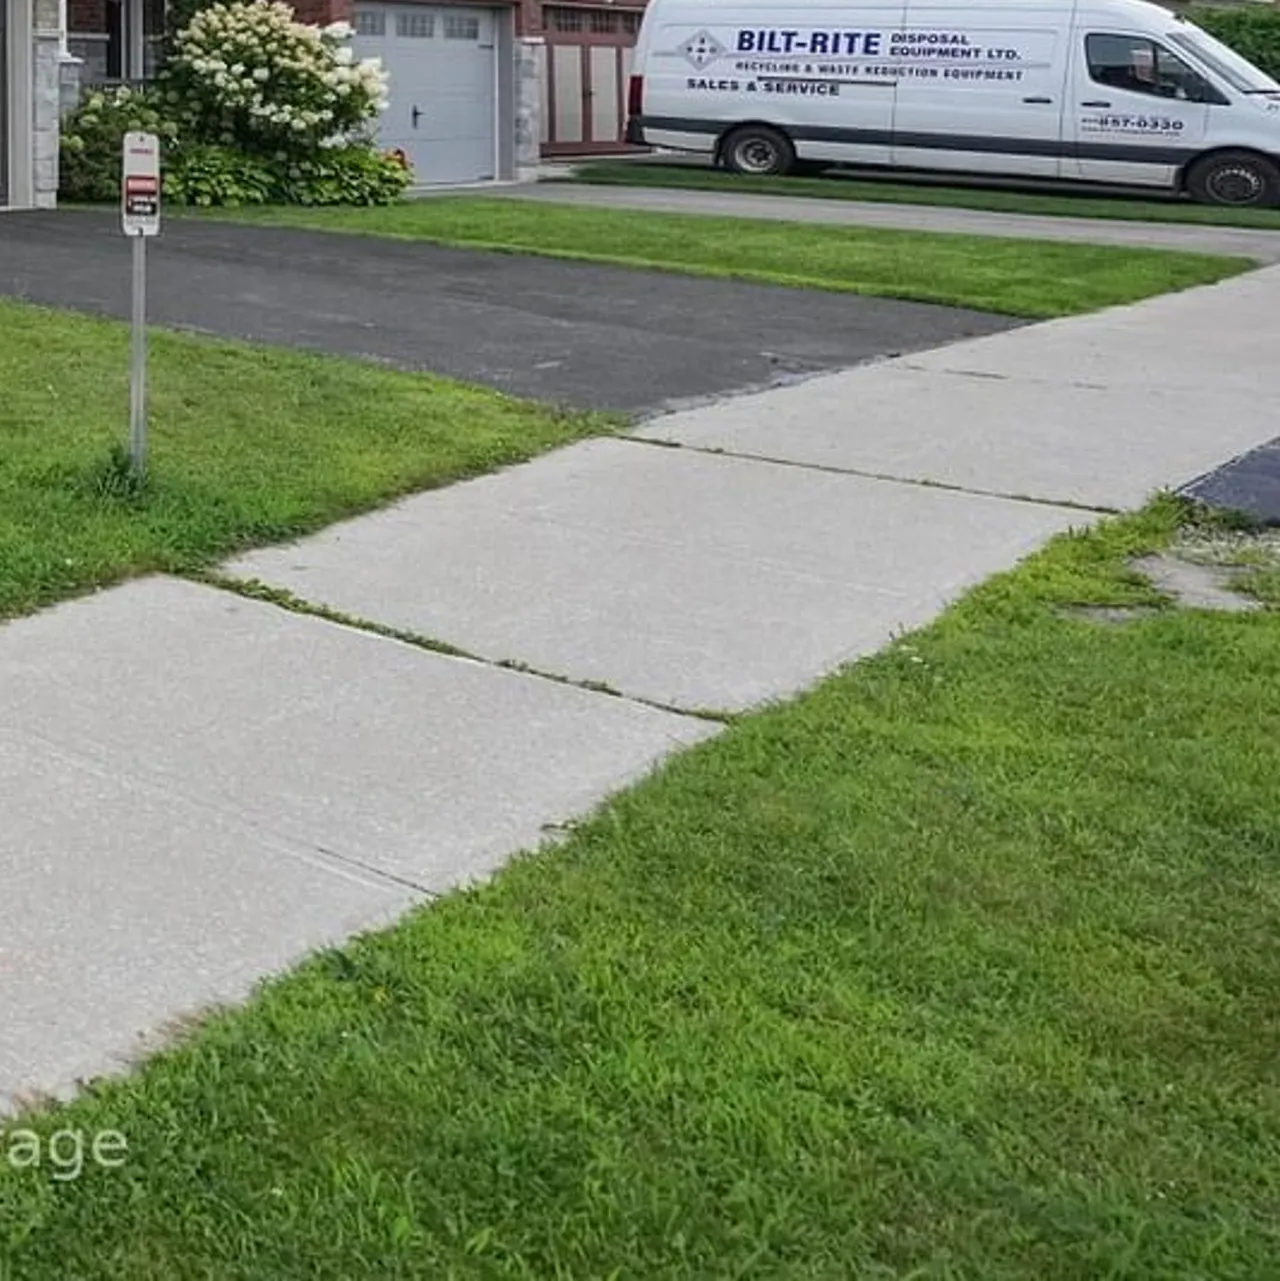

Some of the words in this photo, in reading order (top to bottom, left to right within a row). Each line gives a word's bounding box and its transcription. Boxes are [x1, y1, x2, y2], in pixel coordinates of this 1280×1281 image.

[737, 30, 881, 56] BILT-RITE
[891, 33, 970, 45] DISPOSAL
[890, 46, 981, 58] EQUIPMENT
[987, 49, 1022, 60] LTD.
[735, 61, 799, 73] RECYCLING
[817, 64, 859, 75] WASTE
[865, 66, 939, 78] REDUCTION
[944, 69, 1023, 81] EQUIPMENT
[687, 78, 740, 91] SALES
[746, 81, 758, 92] &
[763, 82, 840, 97] SERVICE
